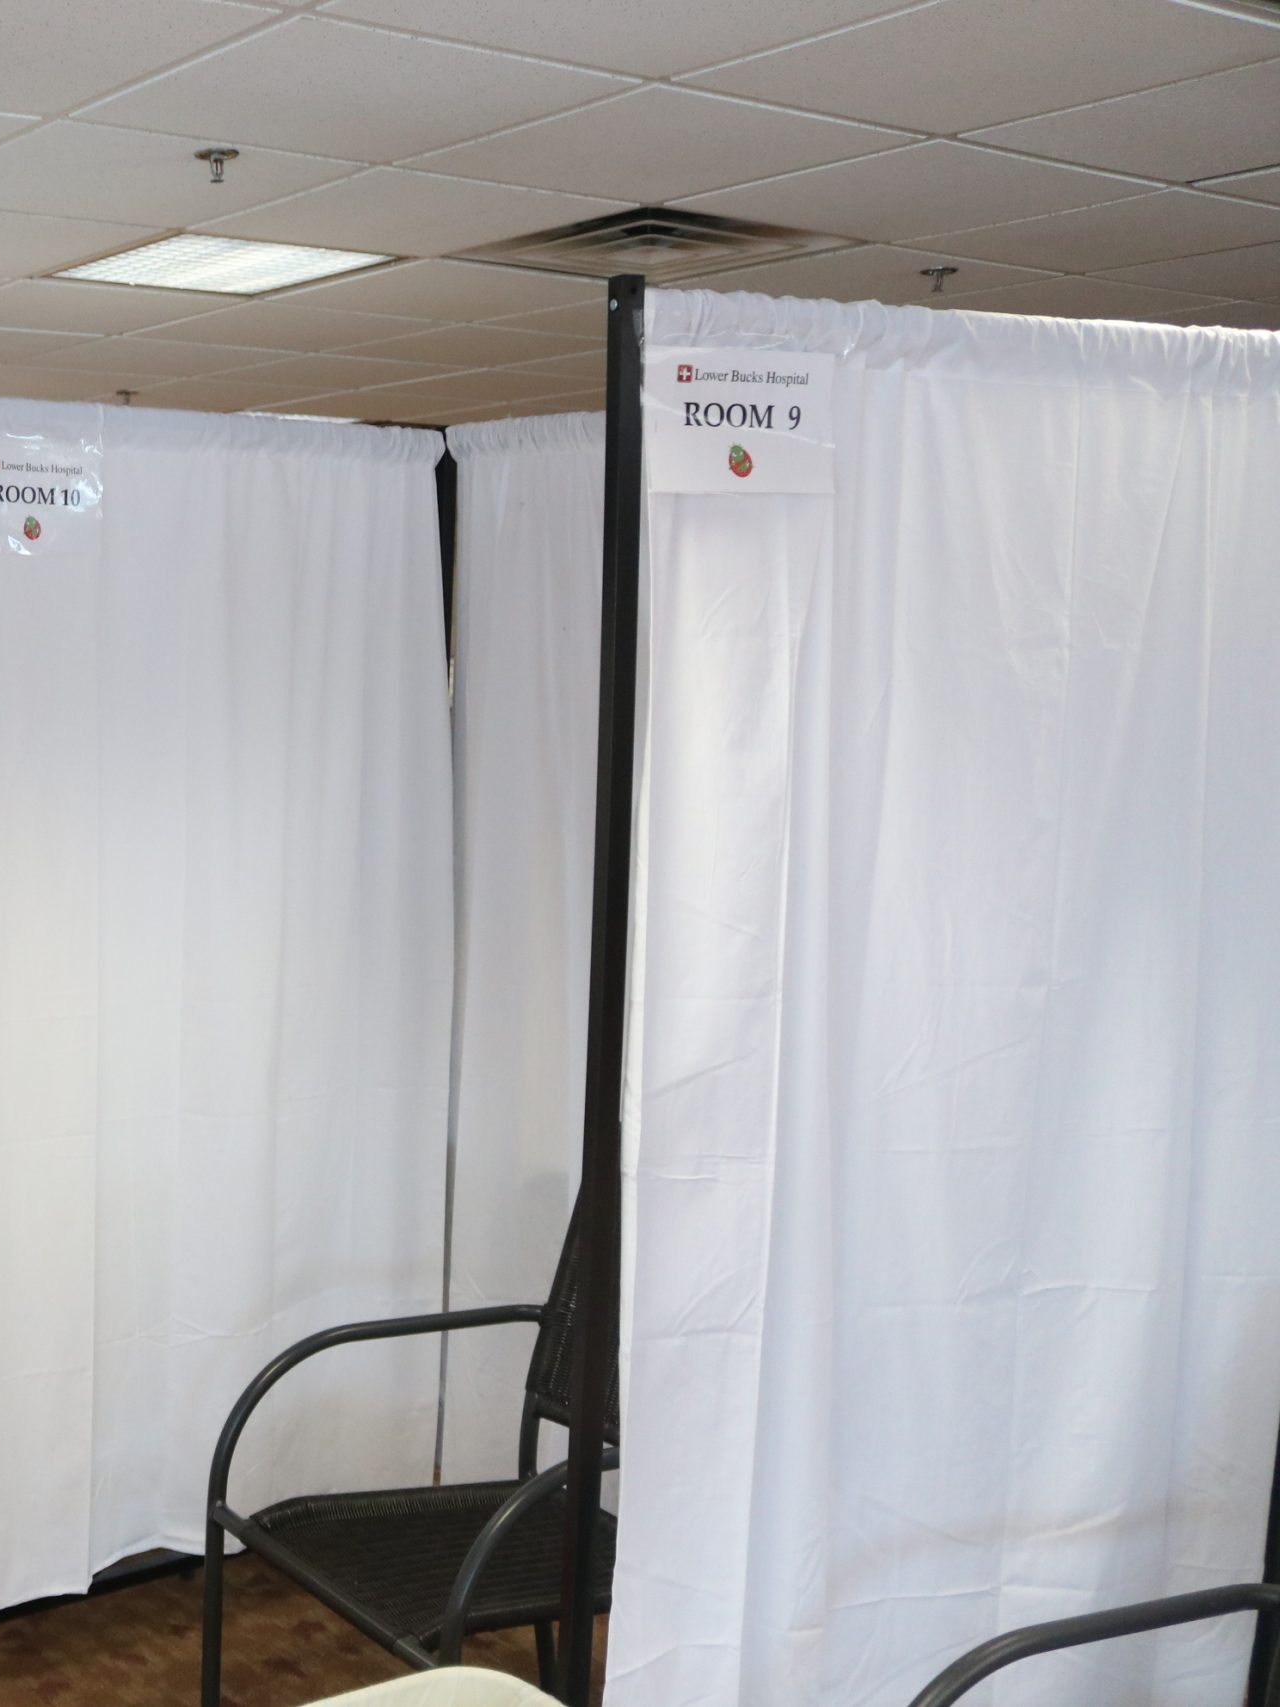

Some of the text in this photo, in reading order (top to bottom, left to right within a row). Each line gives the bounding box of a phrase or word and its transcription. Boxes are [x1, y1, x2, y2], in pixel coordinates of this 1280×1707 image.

[694, 368, 809, 387] Lower Bucks Hospital
[683, 402, 802, 430] ROOM 9
[2, 461, 82, 476] Lower Bucks Hospital
[60, 489, 81, 507] 10
